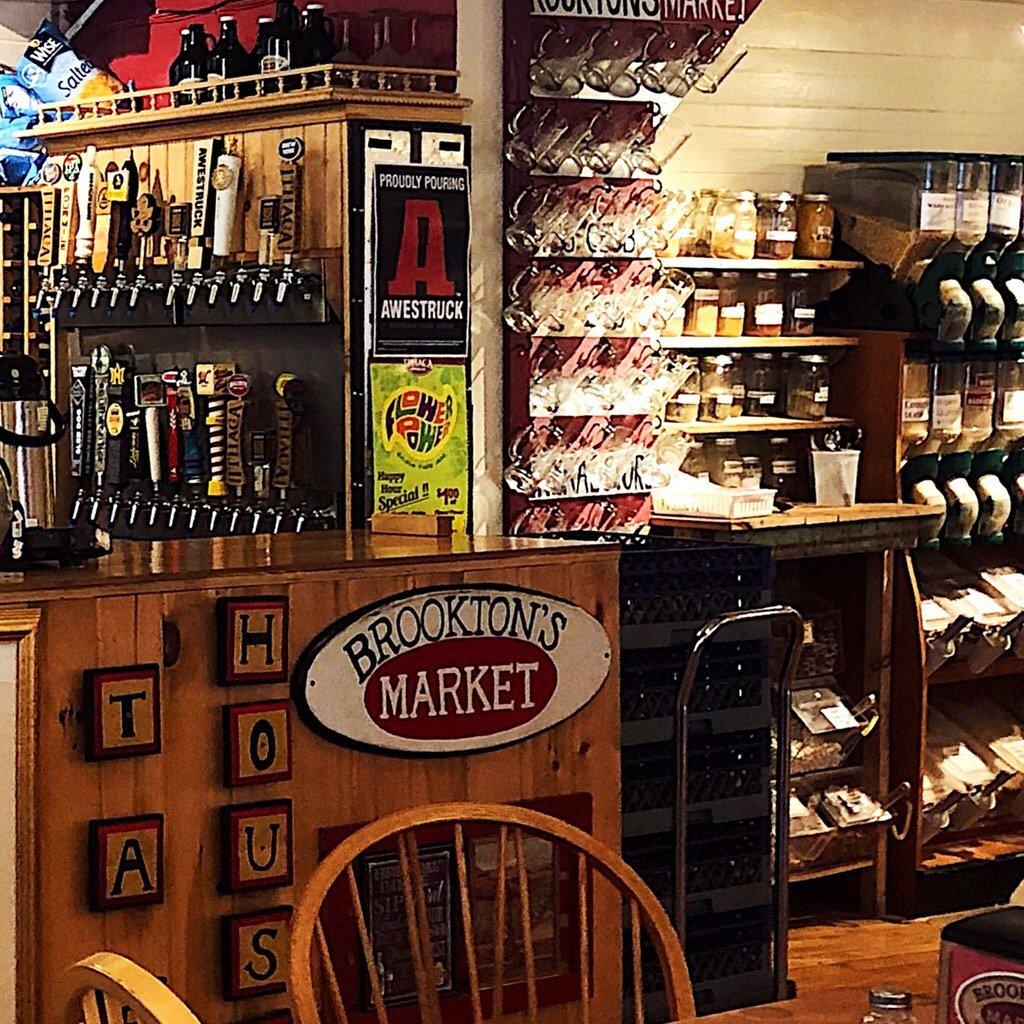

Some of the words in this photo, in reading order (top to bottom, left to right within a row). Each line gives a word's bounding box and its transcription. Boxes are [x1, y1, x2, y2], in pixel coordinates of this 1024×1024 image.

[30, 37, 63, 63] WISE
[193, 148, 207, 228] AWESTRUCK
[379, 173, 422, 189] PROUDLY
[424, 175, 465, 191] POURING
[381, 299, 464, 320] AWESTRUCK
[377, 470, 406, 484] Happy
[378, 487, 419, 512] Special
[343, 595, 567, 684] BROOKTON'S
[380, 661, 539, 720] MARKET
